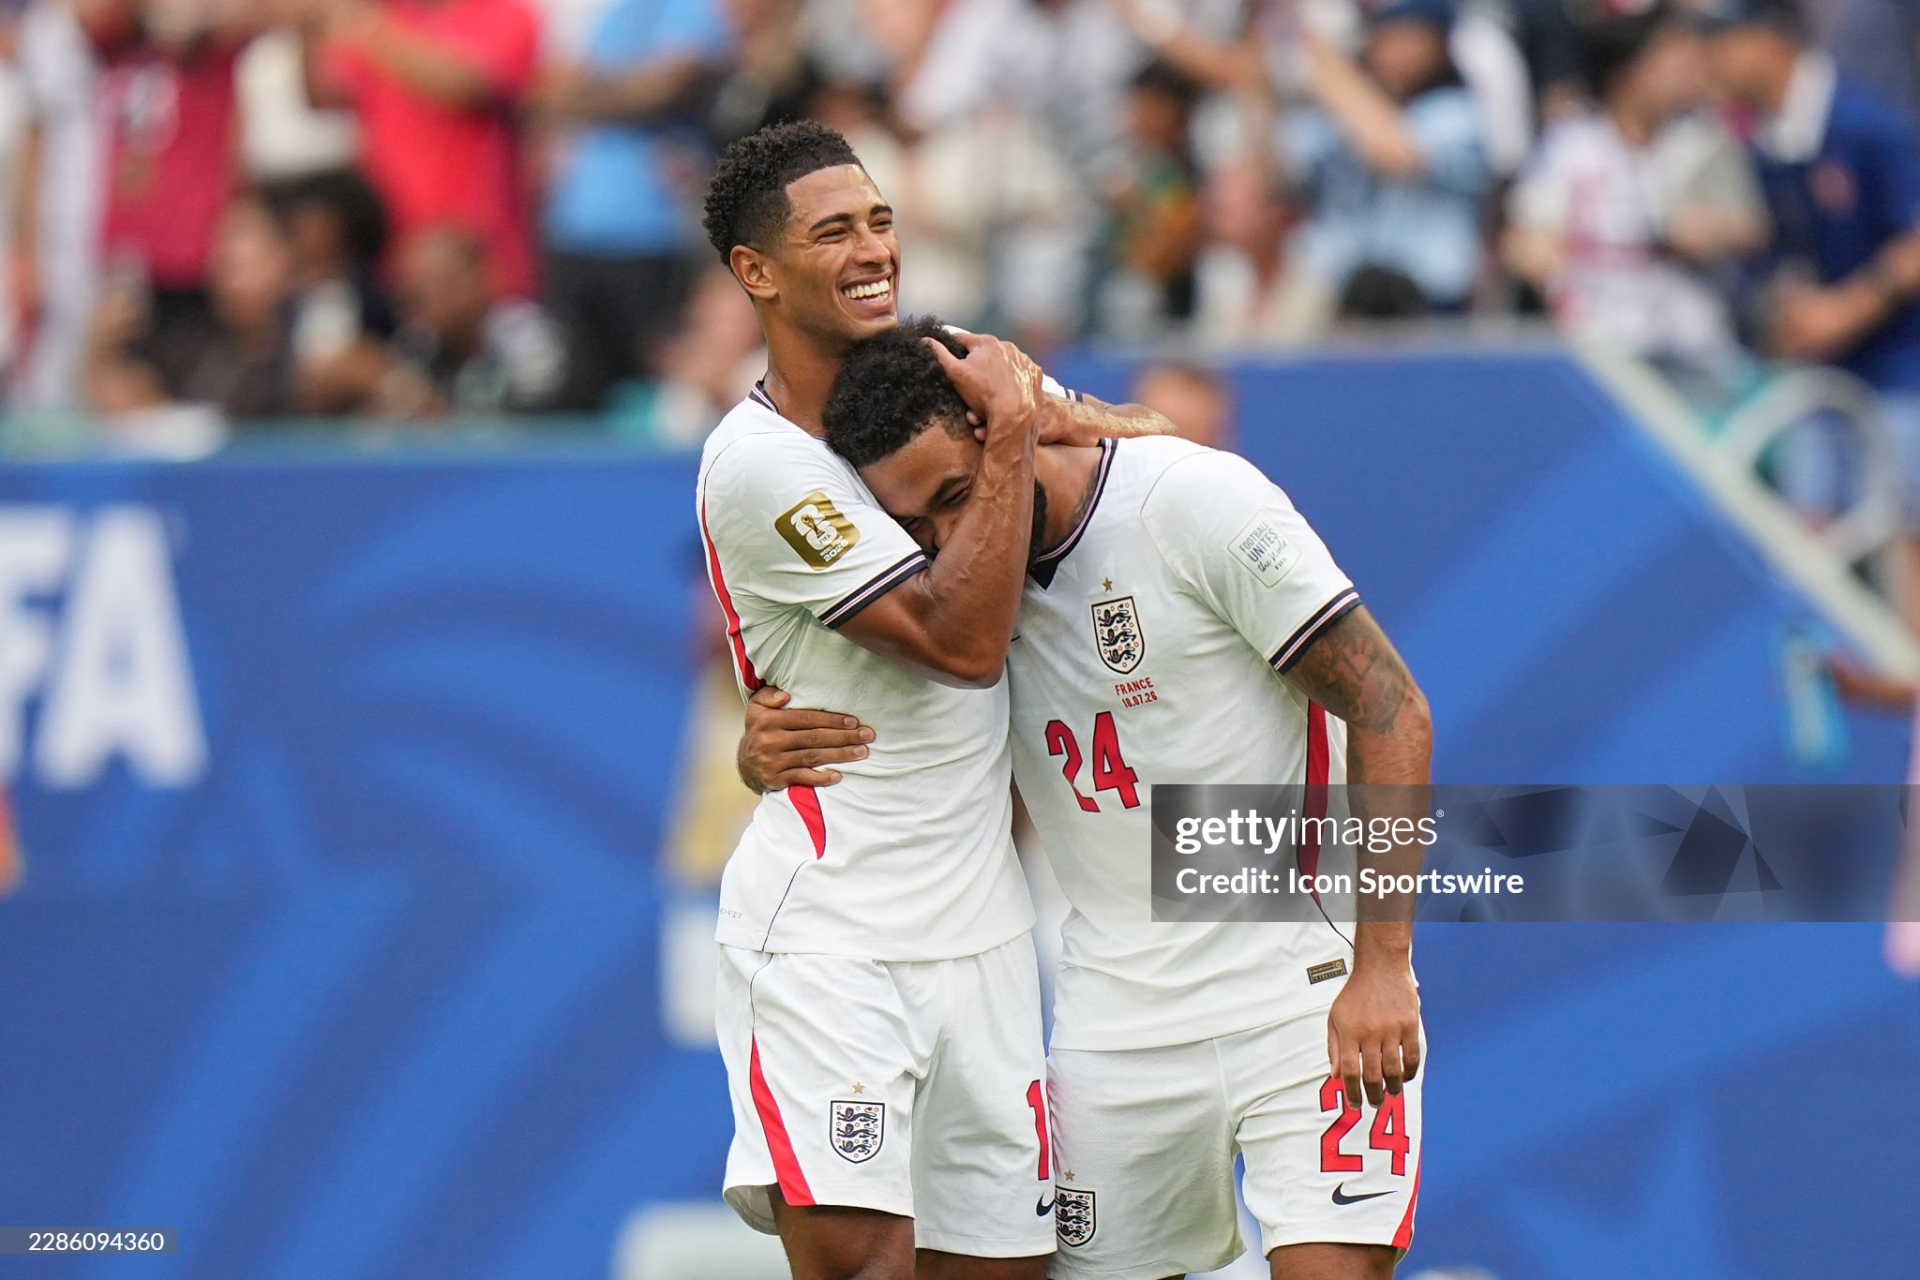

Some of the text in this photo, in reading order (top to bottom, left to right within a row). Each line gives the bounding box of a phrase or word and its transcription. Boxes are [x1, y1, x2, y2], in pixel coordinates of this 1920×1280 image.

[1239, 521, 1269, 554] FOOTBALL
[1247, 528, 1278, 562] UNITES
[1257, 559, 1272, 573] the
[1115, 676, 1154, 696] FRANCE
[1045, 711, 1141, 813] 24
[1319, 1075, 1410, 1177] 24
